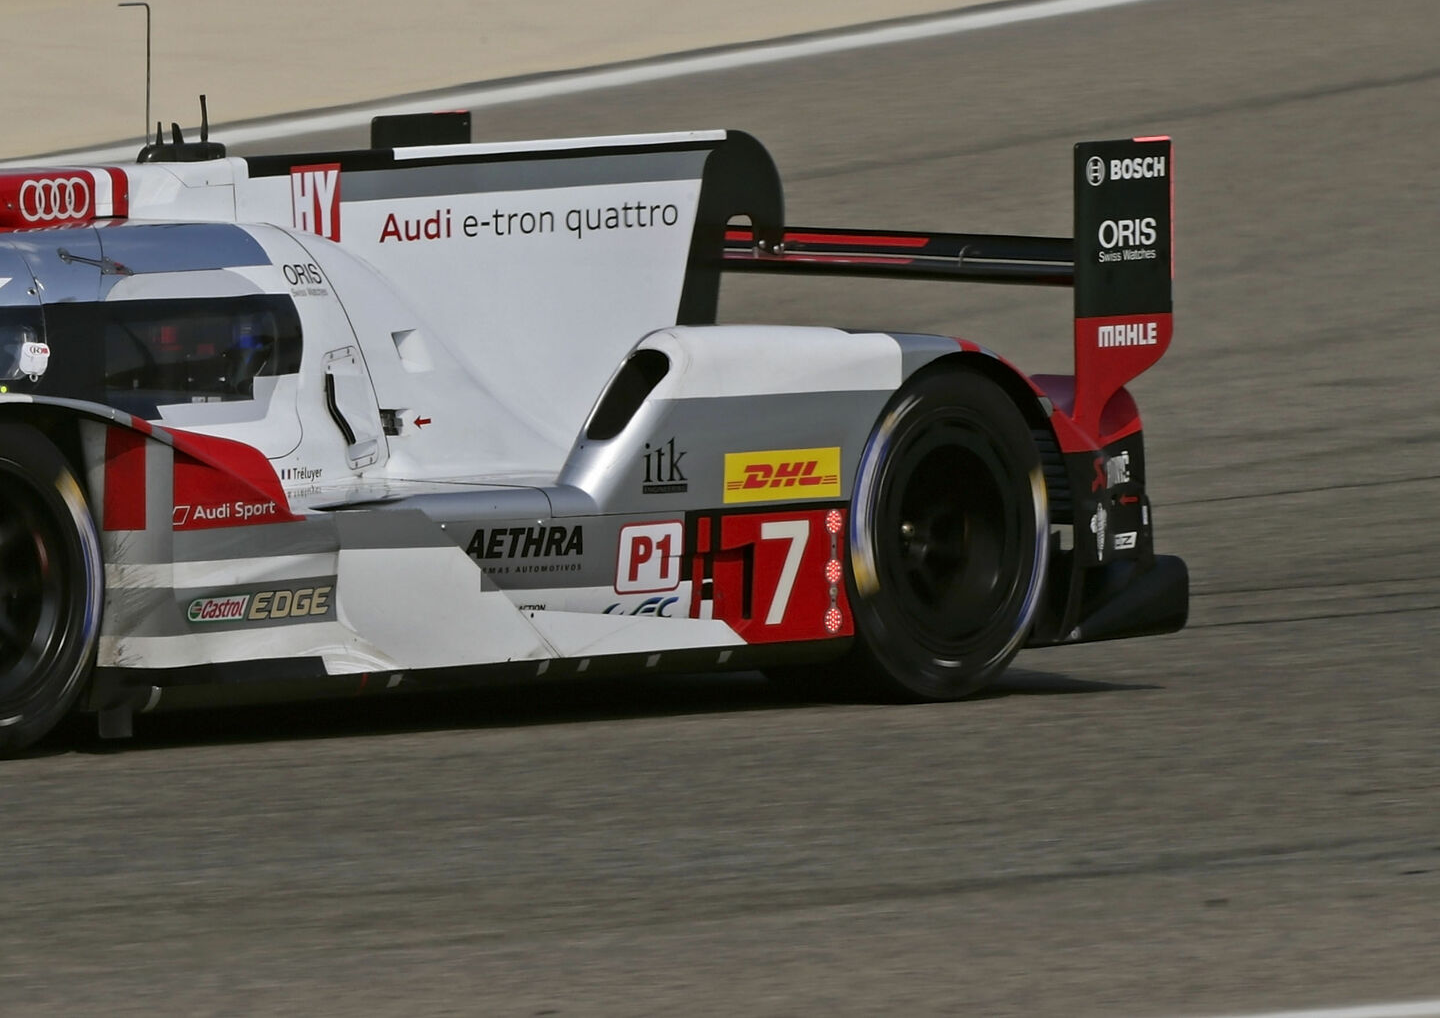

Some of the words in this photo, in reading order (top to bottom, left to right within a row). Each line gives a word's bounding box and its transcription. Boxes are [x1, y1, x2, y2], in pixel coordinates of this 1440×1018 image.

[1110, 156, 1166, 181] BOSCH
[292, 169, 339, 239] HY
[379, 208, 452, 244] Audi
[462, 209, 555, 238] e-tron
[565, 201, 679, 239] quattro
[1098, 217, 1157, 249] ORIS
[1098, 250, 1123, 263] Swiss
[1123, 247, 1157, 261] Watches
[282, 263, 322, 285] ORIS
[1098, 322, 1158, 348] MAHLE
[642, 436, 689, 483] itk
[741, 460, 824, 490] DHL
[193, 502, 231, 521] Audi
[234, 500, 276, 519] Sport
[465, 525, 584, 559] AETHRA
[628, 533, 672, 582] P1
[515, 563, 582, 574] AUTOMOTIVOS
[760, 519, 810, 625] 7
[201, 597, 247, 619] Castrol
[247, 586, 332, 621] EDGE
